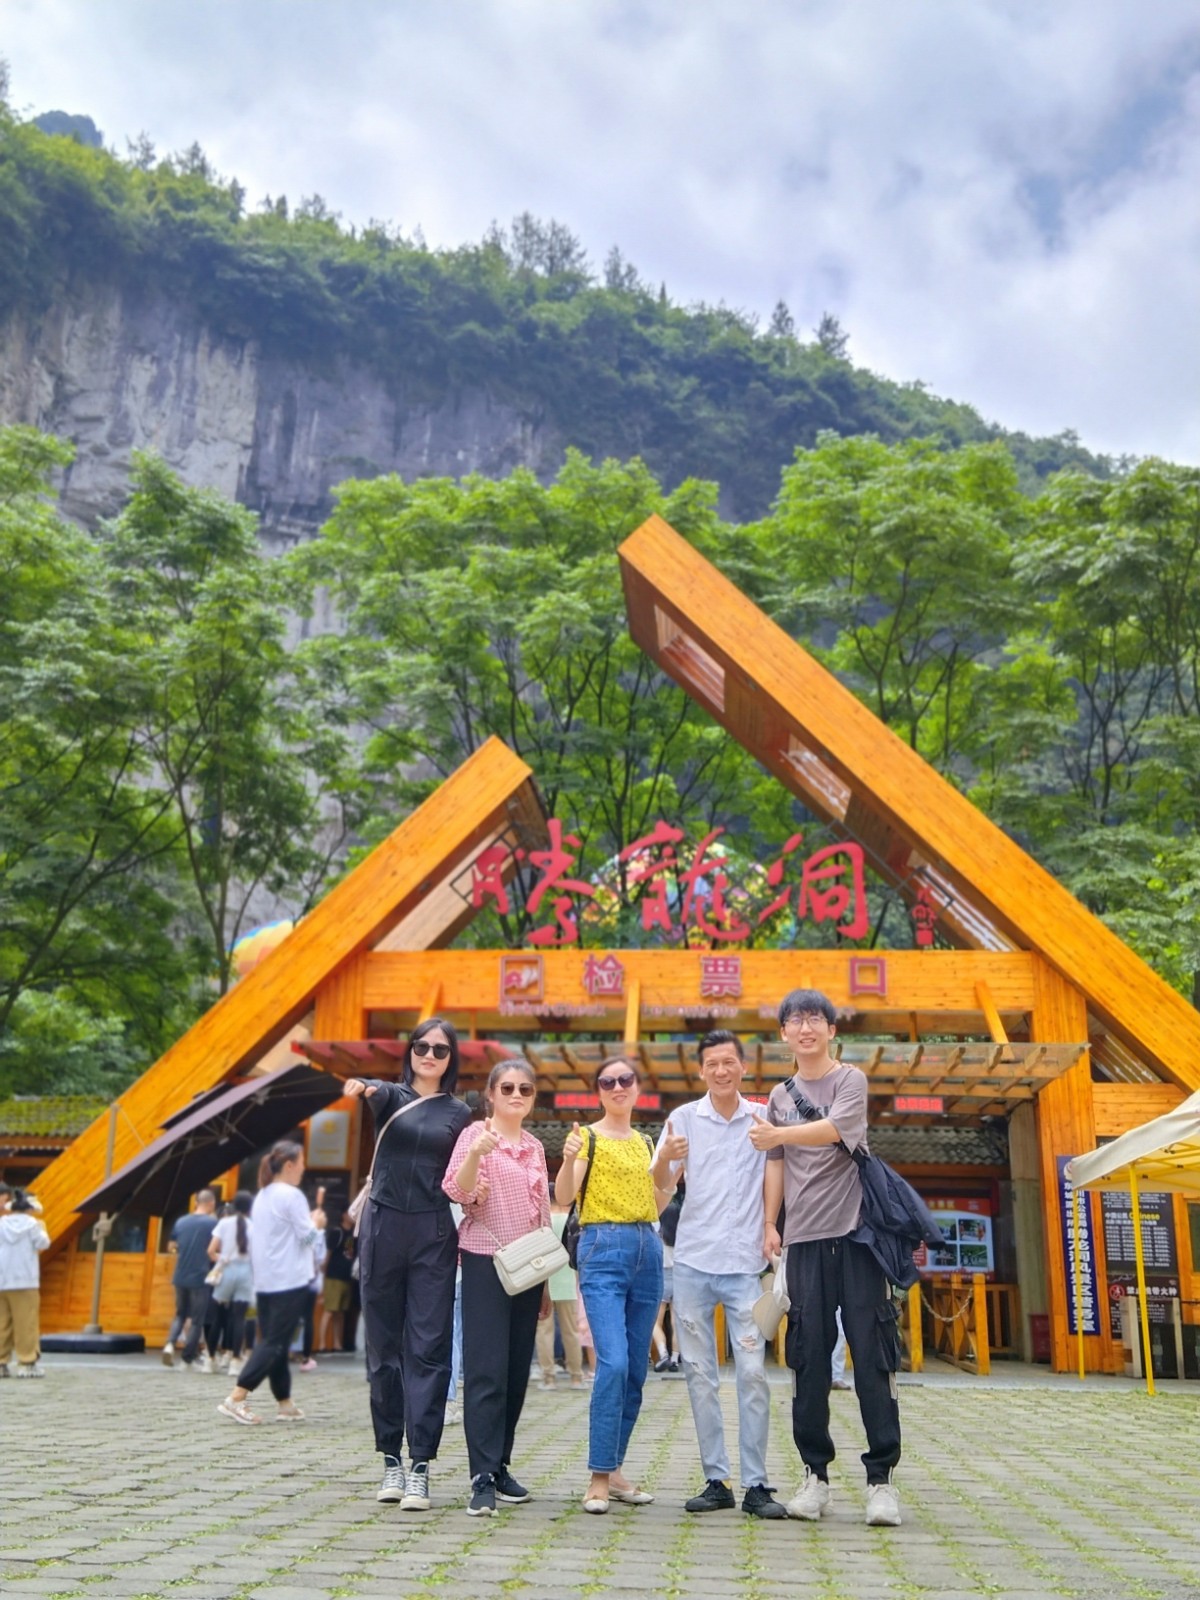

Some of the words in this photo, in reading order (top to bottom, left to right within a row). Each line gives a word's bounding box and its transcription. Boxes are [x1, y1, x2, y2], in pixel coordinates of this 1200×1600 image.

[583, 953, 886, 997] 检票口
[551, 1003, 607, 1017] Check
[1129, 1212, 1160, 1220] Cinese
